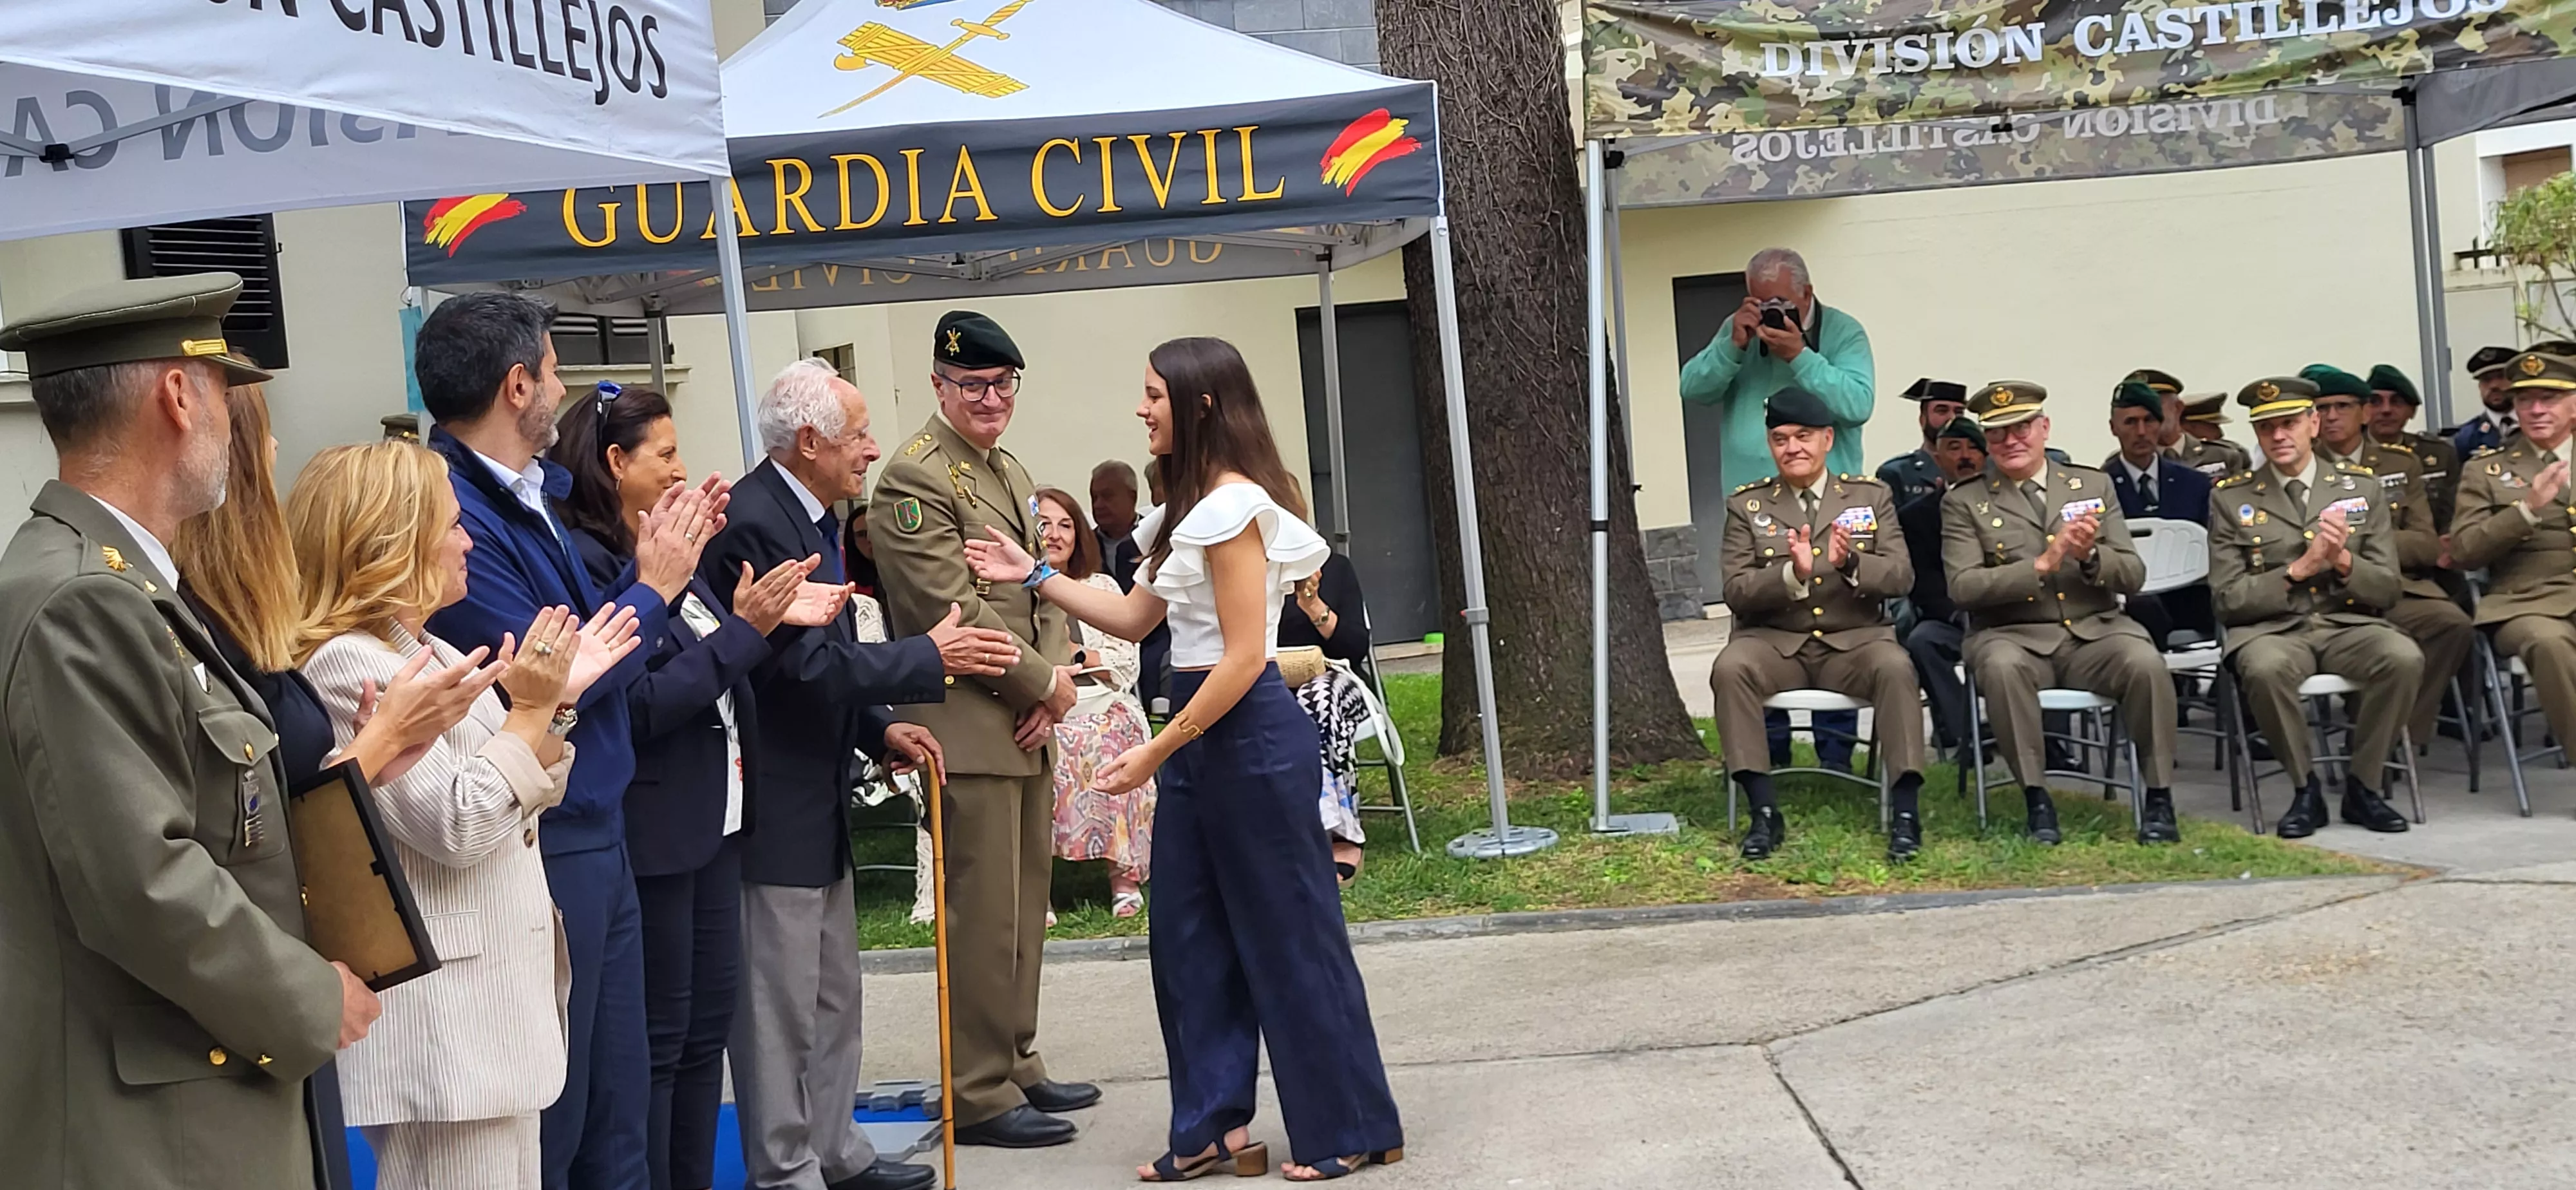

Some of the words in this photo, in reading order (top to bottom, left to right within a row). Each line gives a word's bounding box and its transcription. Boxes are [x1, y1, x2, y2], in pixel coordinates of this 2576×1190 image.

[1759, 14, 2046, 78] DIVISIÓN
[562, 144, 998, 248] GUARDIA
[1030, 125, 1287, 218] CIVIL
